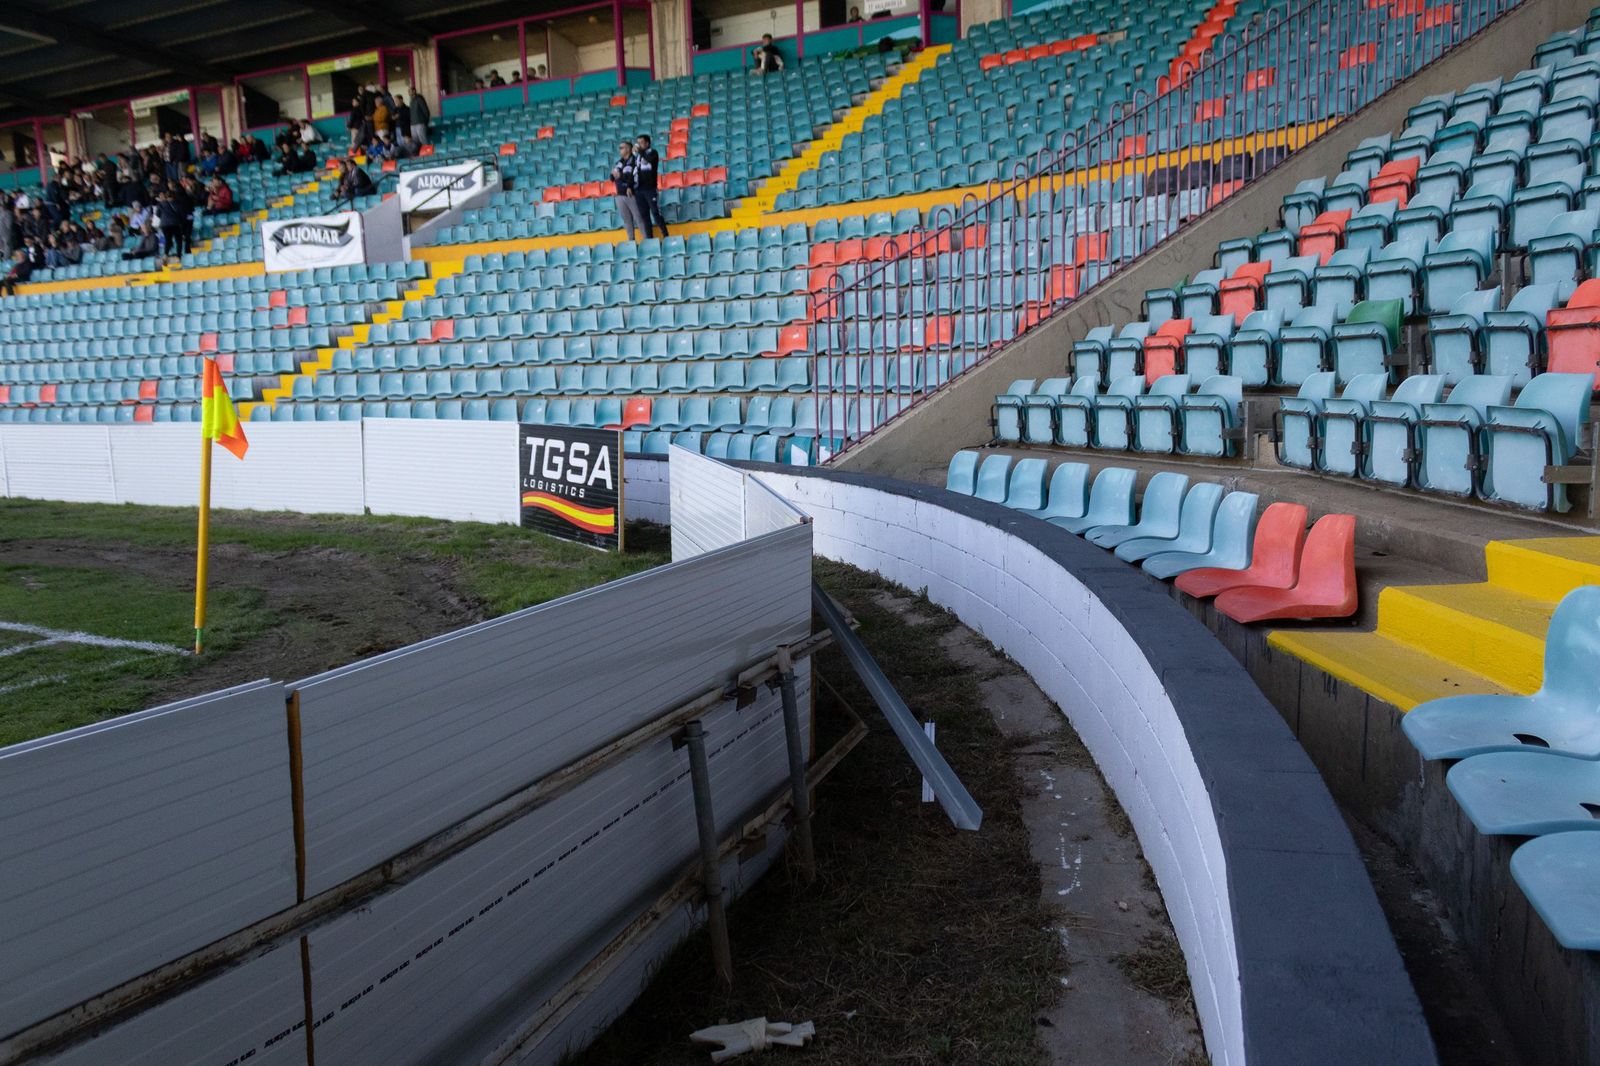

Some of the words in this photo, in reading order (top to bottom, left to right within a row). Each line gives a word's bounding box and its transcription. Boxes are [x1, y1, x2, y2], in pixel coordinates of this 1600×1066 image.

[417, 174, 465, 189] ALJOMAR
[282, 226, 340, 244] ALJOMAR
[526, 436, 613, 490] TGSA
[523, 478, 586, 498] LOGISTICS
